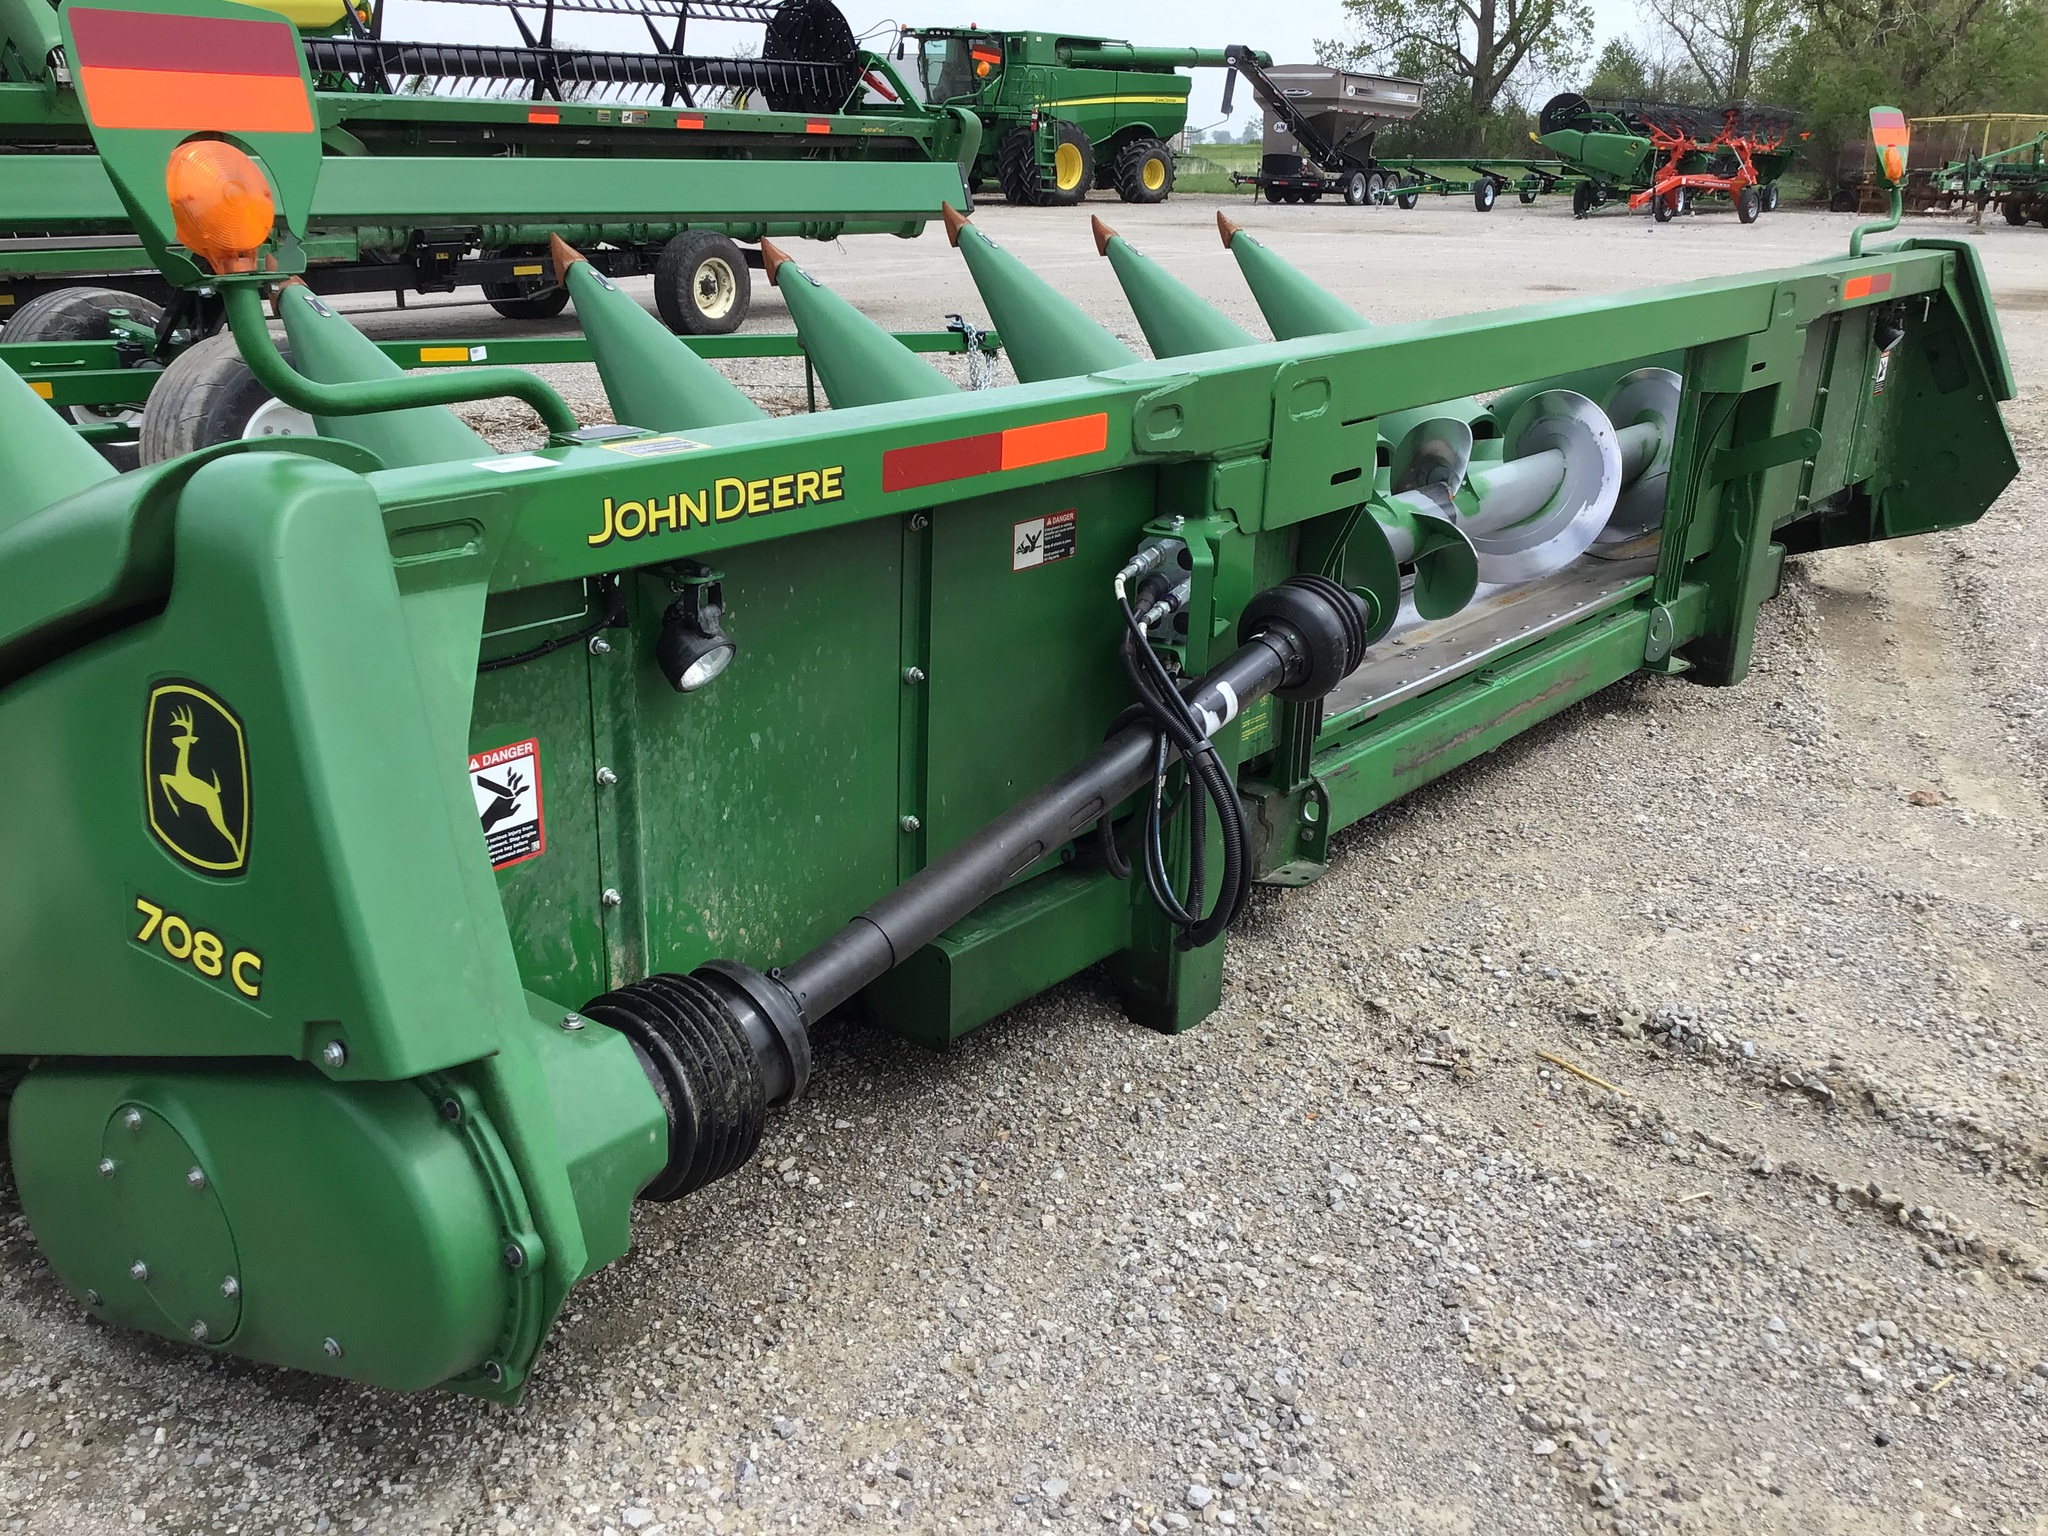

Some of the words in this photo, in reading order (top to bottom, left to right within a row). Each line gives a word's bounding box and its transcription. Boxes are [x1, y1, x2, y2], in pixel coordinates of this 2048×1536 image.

[587, 489, 709, 546] JOHN
[714, 466, 844, 523] DEERE
[1052, 512, 1074, 524] DANGER
[482, 742, 533, 767] DANGER
